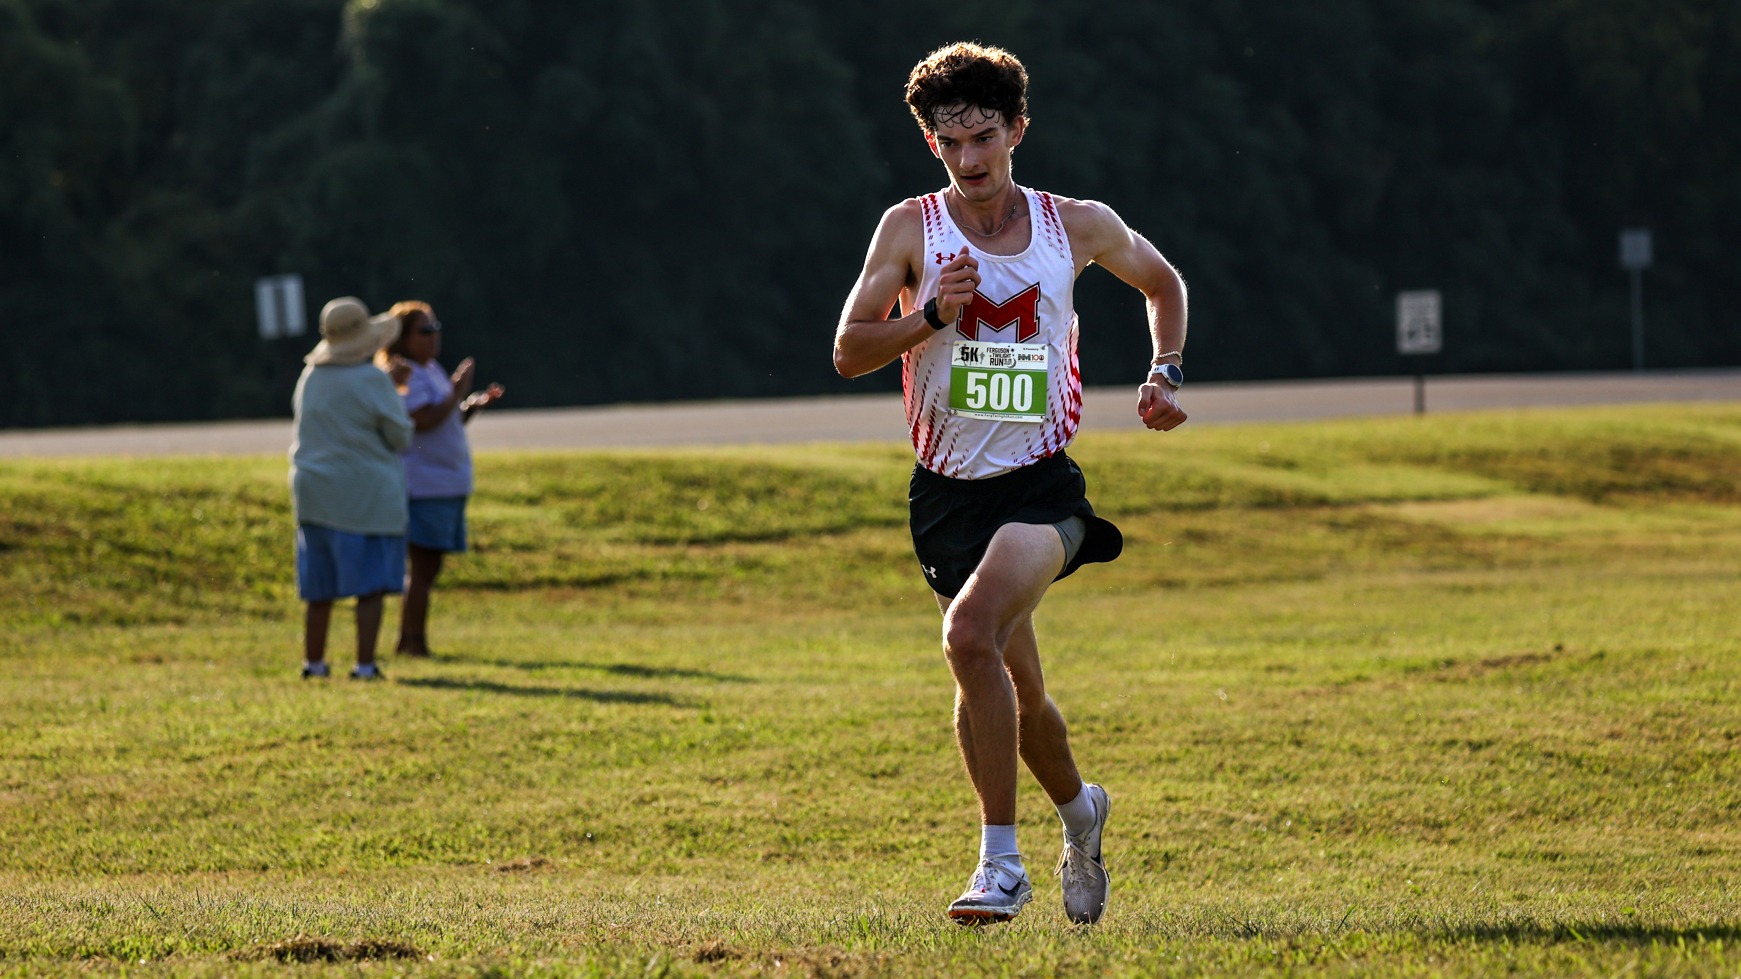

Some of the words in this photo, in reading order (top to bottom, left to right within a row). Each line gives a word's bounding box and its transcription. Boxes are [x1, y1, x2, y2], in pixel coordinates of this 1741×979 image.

[956, 281, 1041, 343] M
[961, 346, 979, 362] 5K
[989, 358, 1004, 366] RUN
[966, 372, 1033, 412] 500
